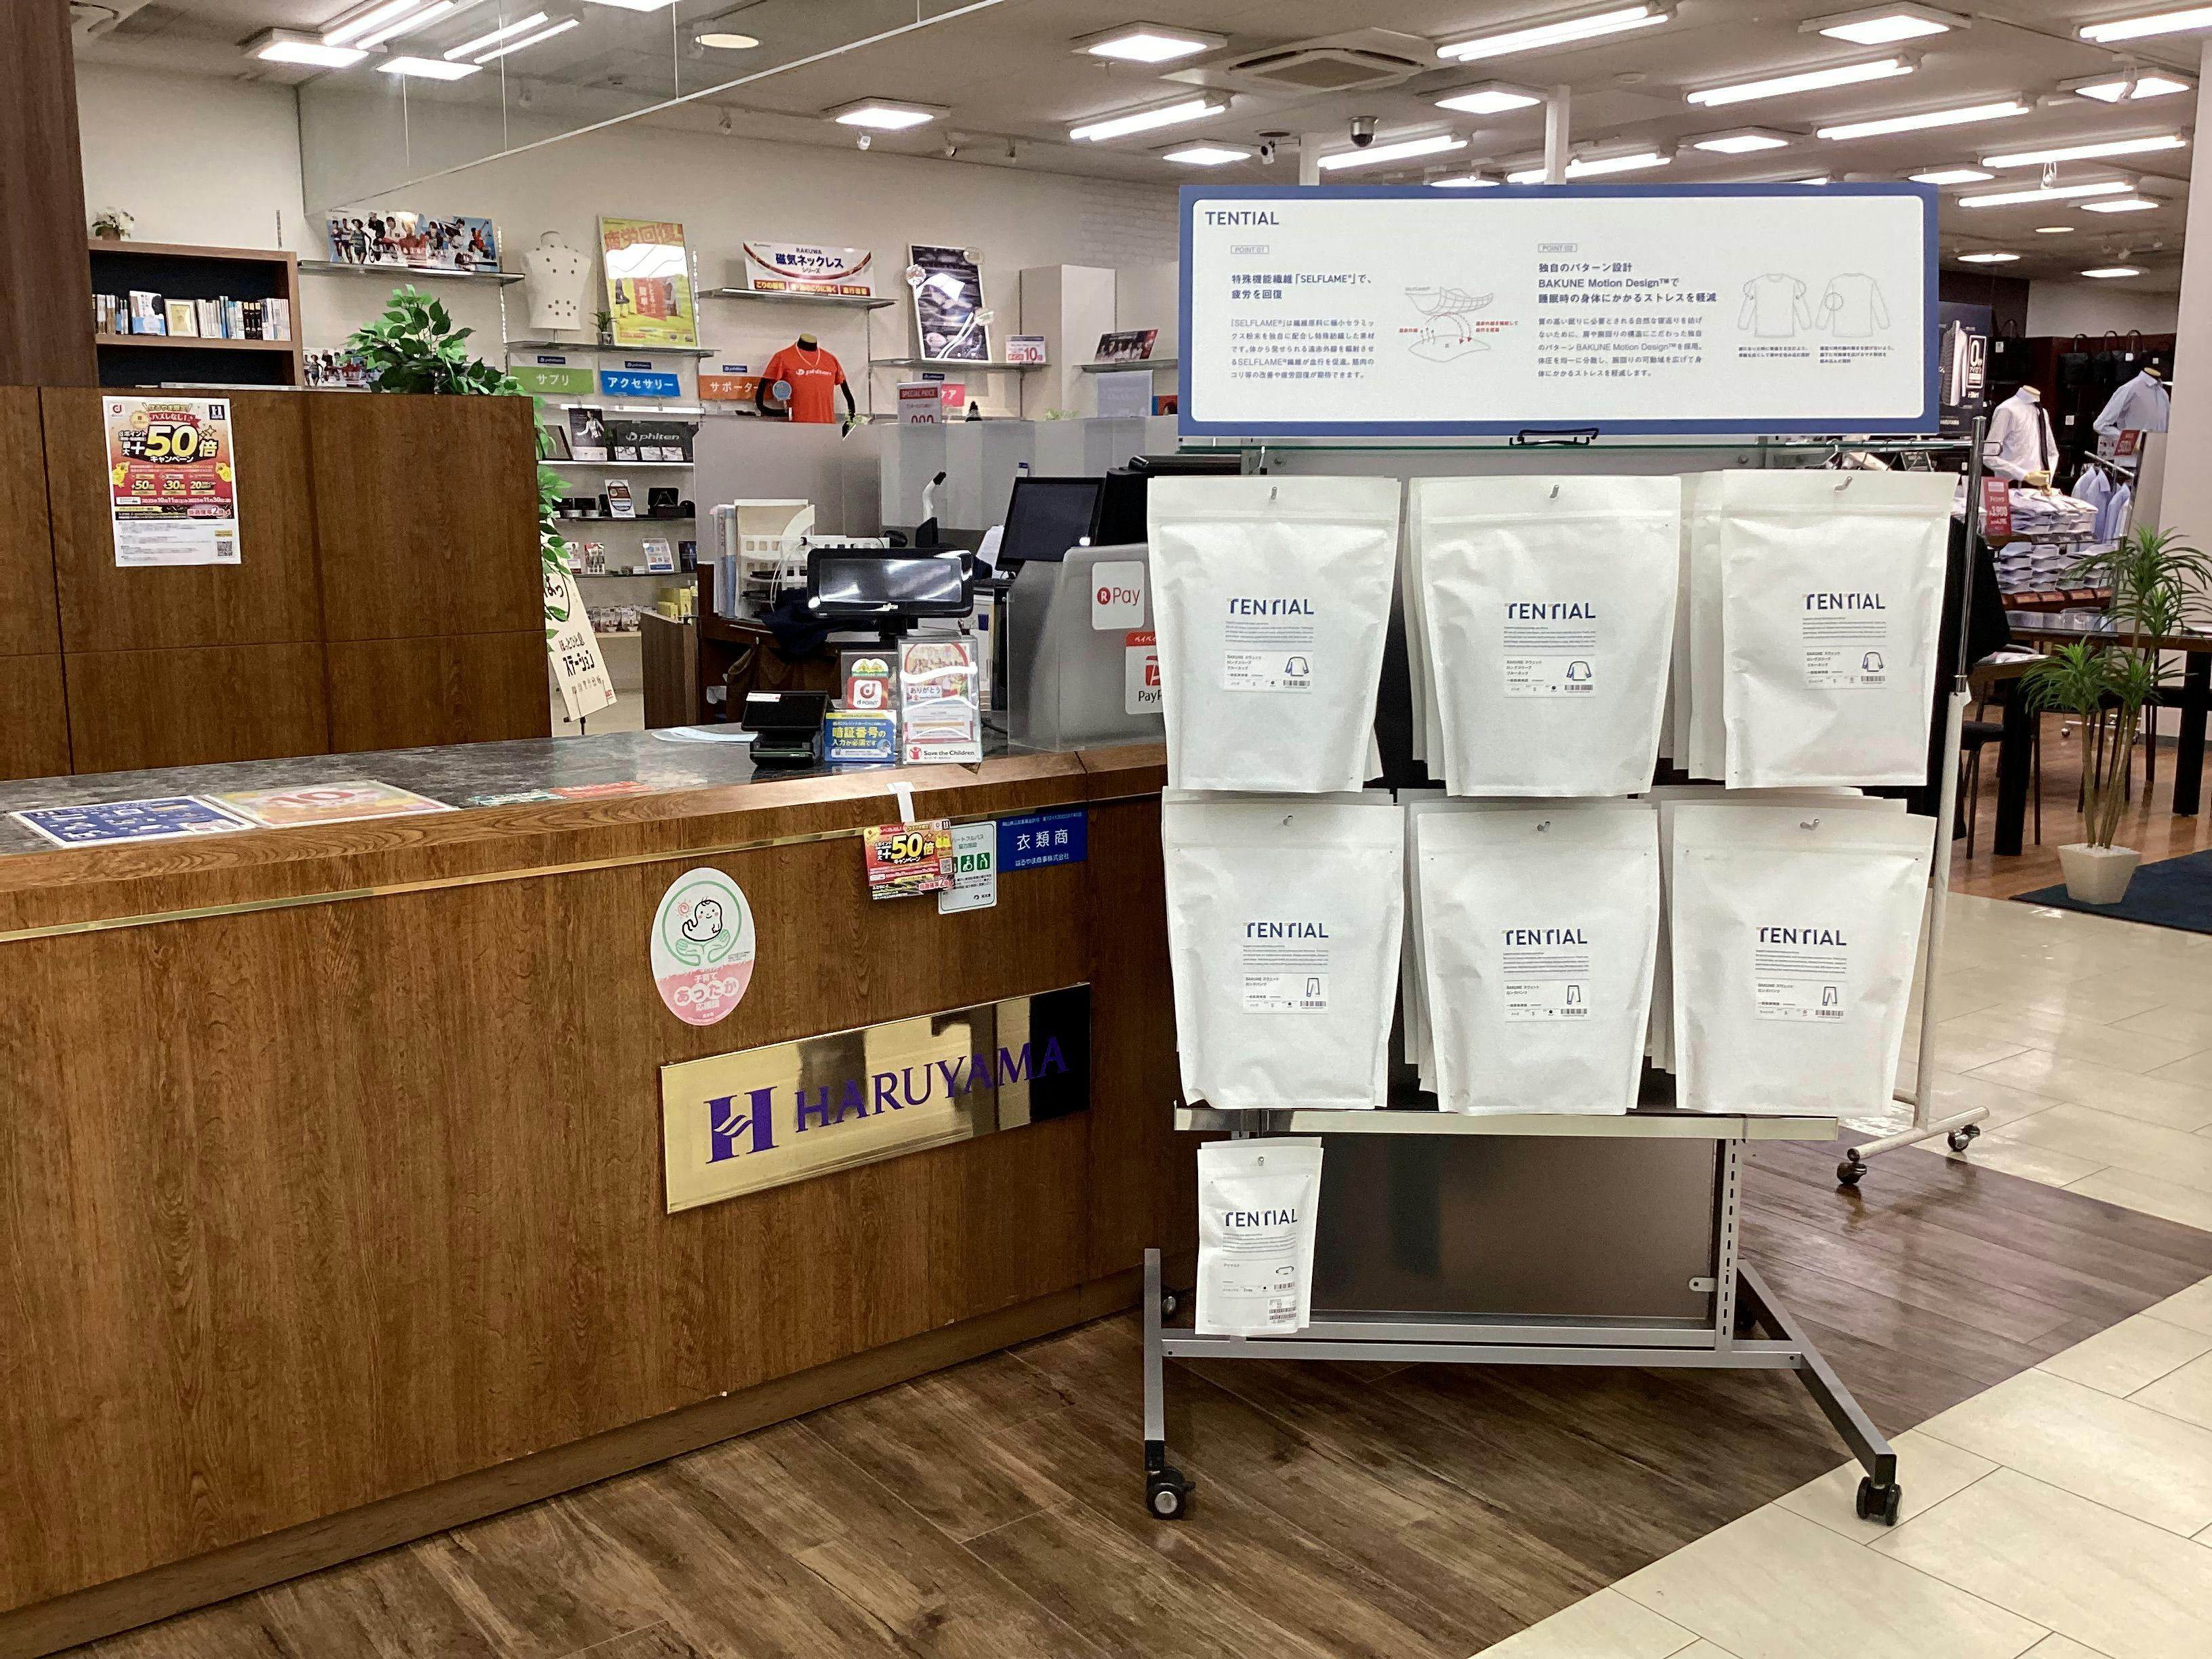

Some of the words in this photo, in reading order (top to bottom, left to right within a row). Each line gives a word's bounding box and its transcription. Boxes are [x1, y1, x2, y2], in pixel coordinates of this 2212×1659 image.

[1205, 211, 1279, 226] TENTIAL
[775, 253, 844, 268] 磁気ネックレス
[1538, 262, 1633, 273] 独自のパターン設計
[1538, 279, 1584, 287] BAKUNE
[1589, 279, 1622, 287] Motion
[1231, 289, 1282, 299] 疲労を回復
[1538, 292, 1717, 304] 睡眠時の身体にかかるストレスを軽減
[536, 373, 569, 386] サプリ
[607, 376, 674, 390] アクセサリー
[639, 431, 680, 442] phiten
[1112, 587, 1141, 607] Pay
[1802, 593, 1886, 610] TENTIAL
[1227, 598, 1314, 615] TENTIAL
[1504, 602, 1596, 619] TENTIAL
[909, 687, 941, 695] ありがとう
[832, 726, 886, 739] 暗証番号の
[1017, 828, 1068, 851] 衣類商
[1243, 922, 1329, 938] TENTIAL
[1502, 928, 1588, 945] TENTIAL
[1756, 926, 1847, 946] TENTIAL
[693, 971, 718, 983] 子育て
[794, 1036, 1072, 1134] HARUYAMA
[1222, 1208, 1298, 1227] TENTIAL
